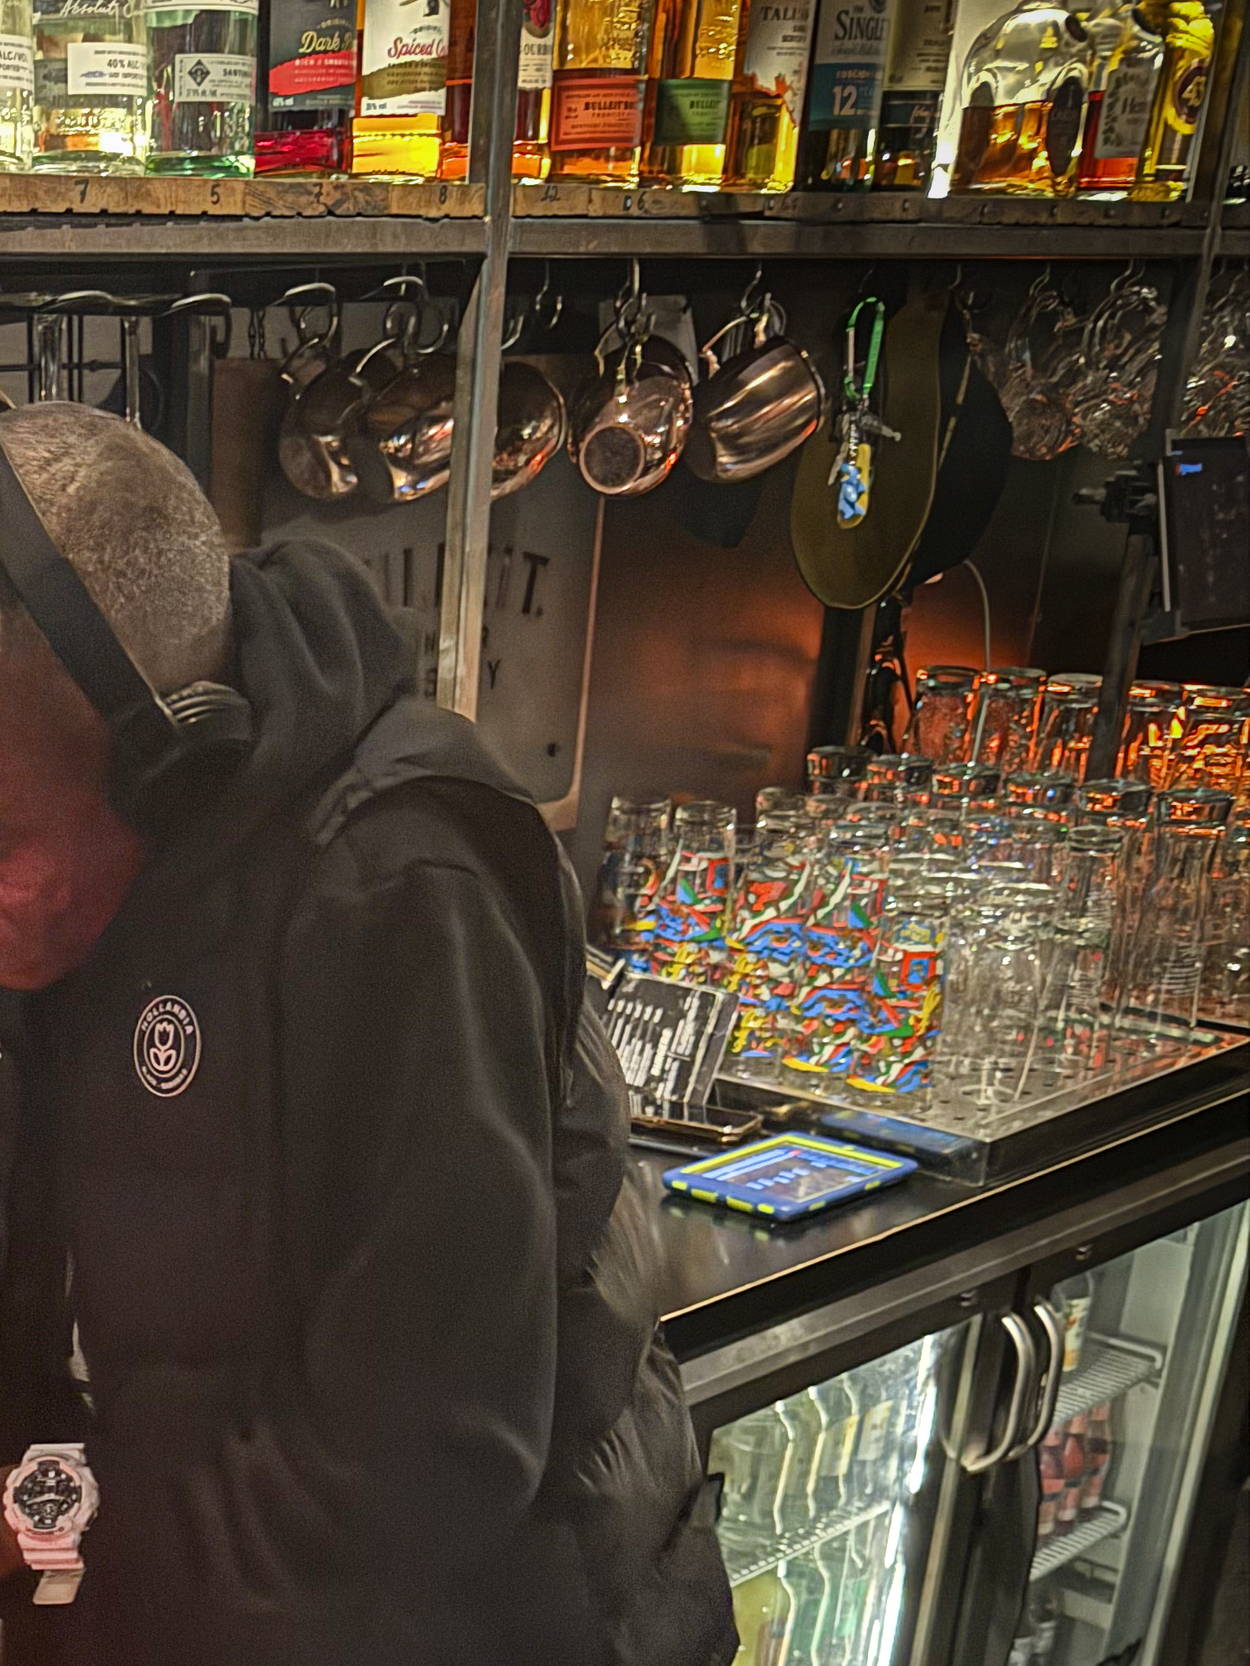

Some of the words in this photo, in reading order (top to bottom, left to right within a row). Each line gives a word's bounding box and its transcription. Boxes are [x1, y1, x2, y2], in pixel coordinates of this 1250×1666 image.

[298, 30, 341, 54] Dark
[387, 36, 434, 60] Spiced
[832, 85, 859, 117] 12
[73, 179, 90, 204] 7
[210, 183, 221, 205] 5
[438, 184, 448, 205] 8
[636, 191, 647, 211] 6
